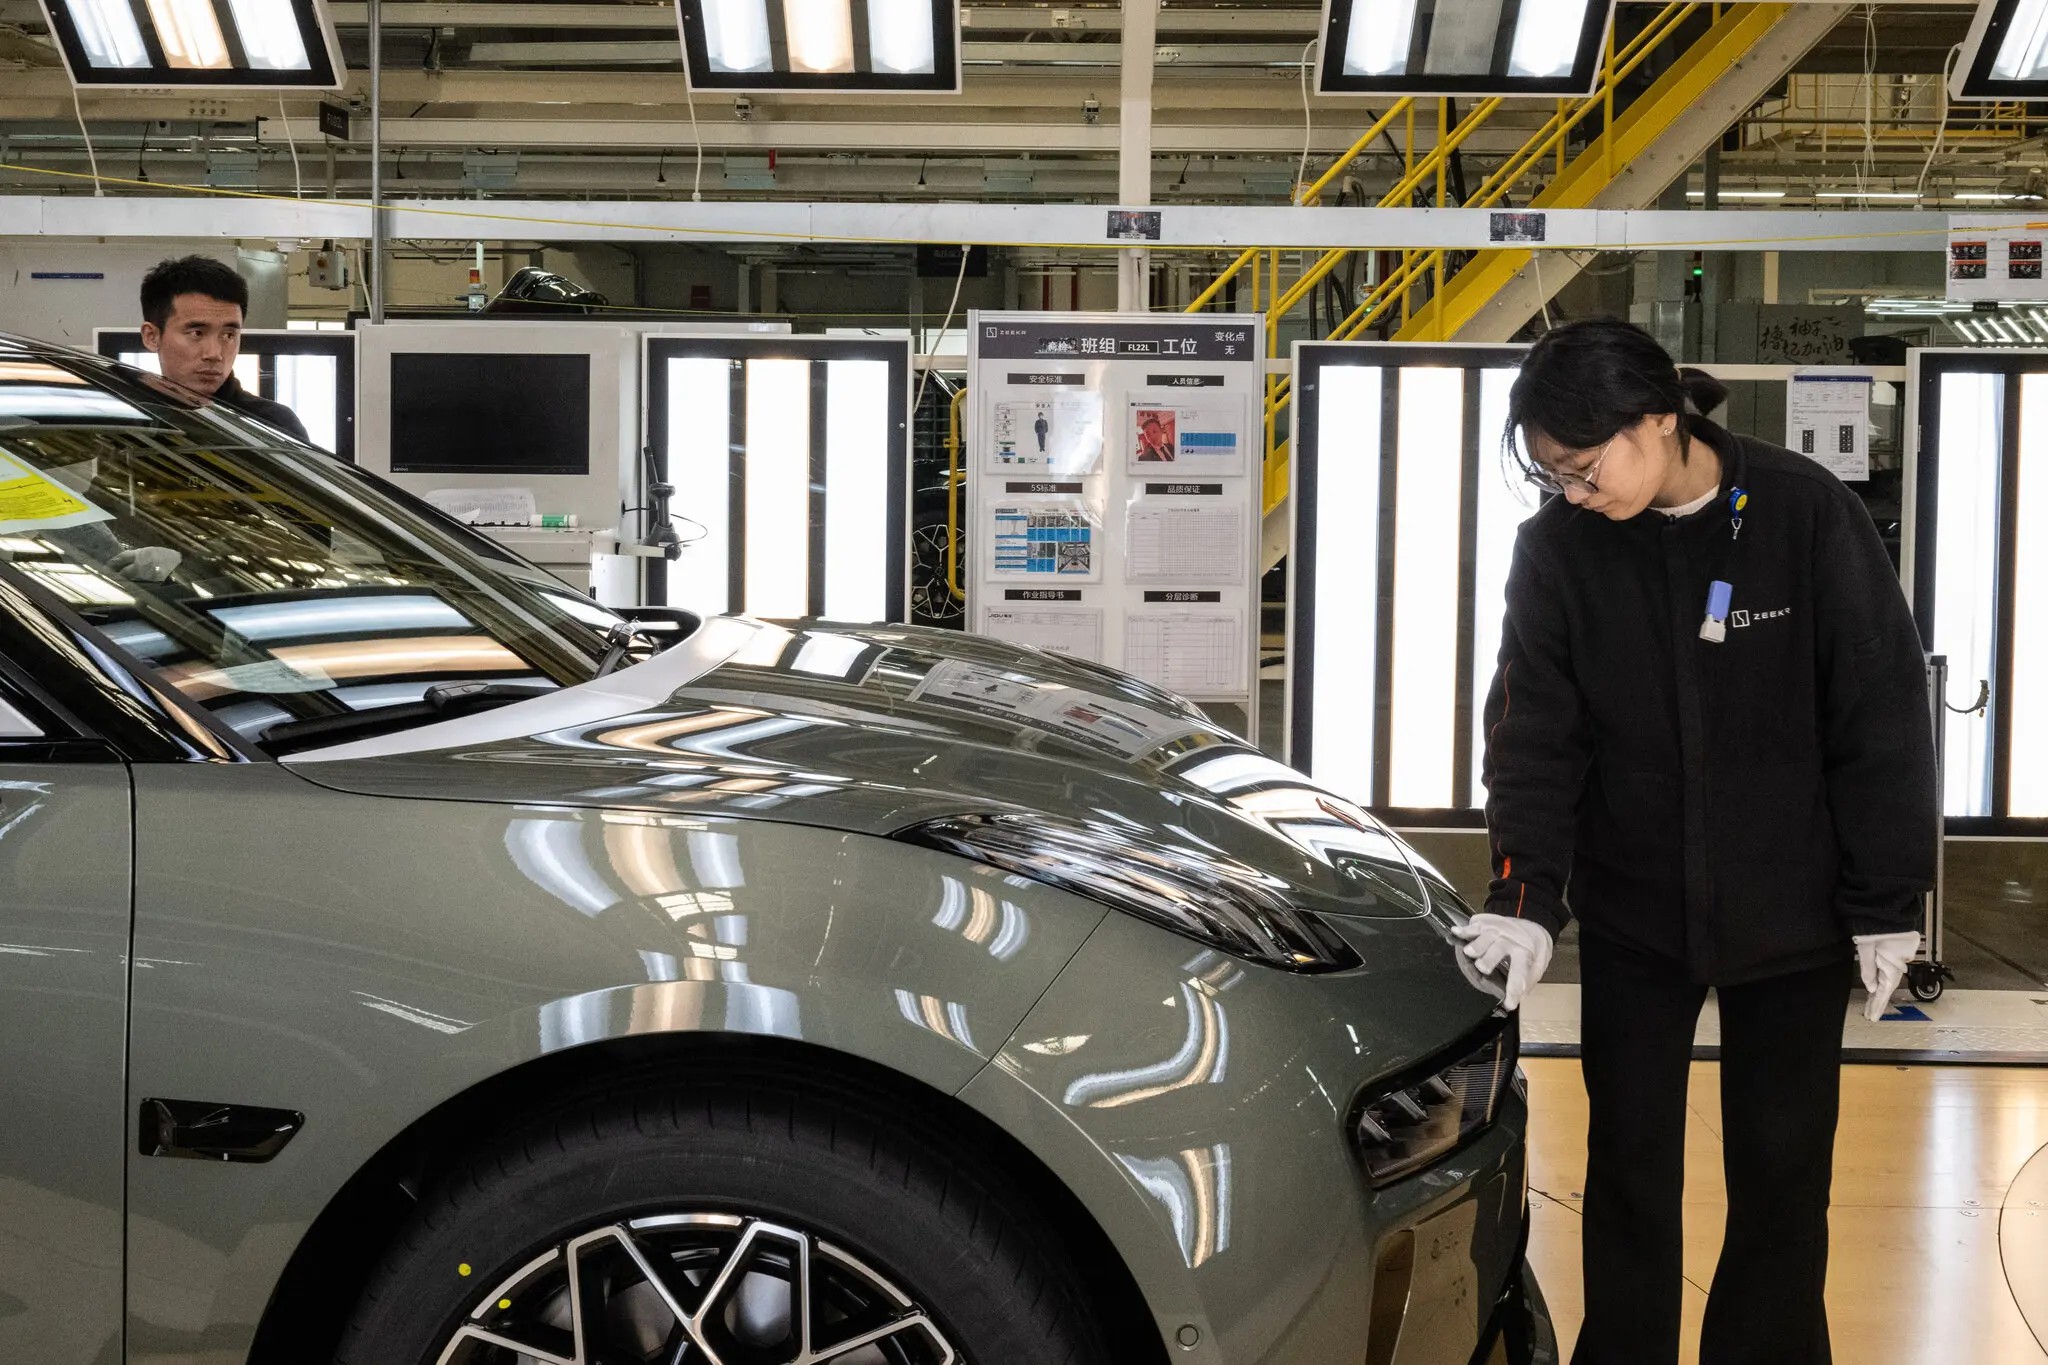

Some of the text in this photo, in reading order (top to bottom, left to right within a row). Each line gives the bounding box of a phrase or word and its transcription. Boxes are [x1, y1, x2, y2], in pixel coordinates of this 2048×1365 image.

[1214, 331, 1246, 342] 变化点
[1081, 337, 1116, 354] 班组
[1127, 343, 1150, 352] FL22L
[1162, 338, 1198, 355] 工位
[1224, 345, 1235, 355] 无
[1029, 375, 1062, 384] 安全标准
[1172, 377, 1200, 385] 人员信息
[1031, 484, 1056, 493] 5S标准
[1167, 485, 1201, 494] 品质保证
[1022, 591, 1065, 600] 作业指导书
[1165, 592, 1199, 601] 分层诊断
[1753, 607, 1791, 620] ZEEKR
